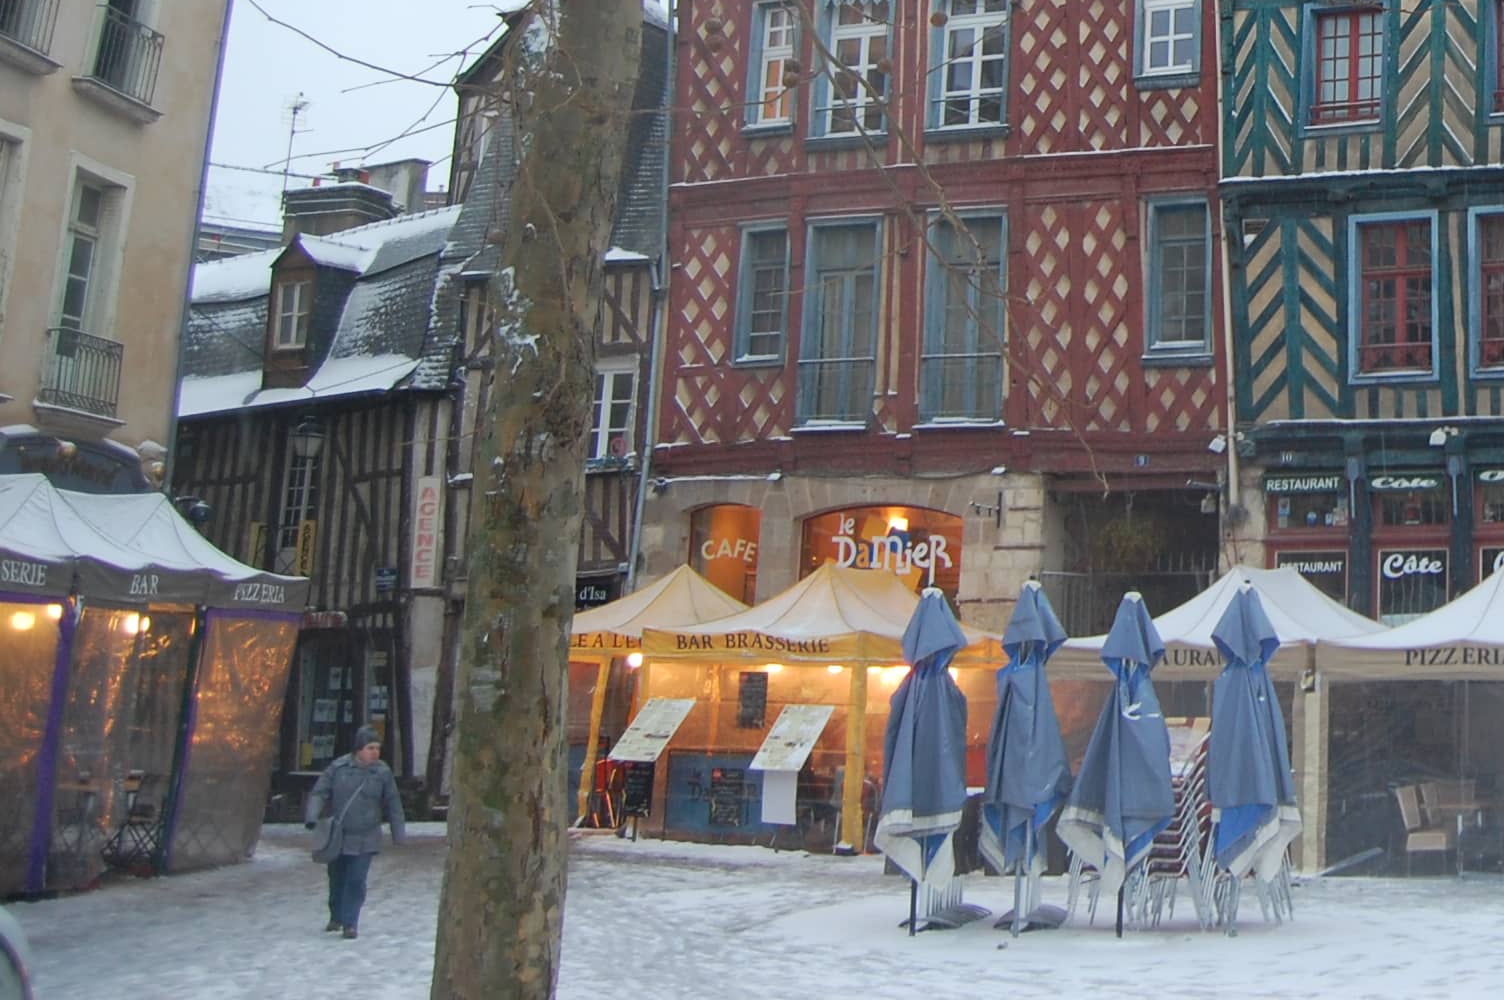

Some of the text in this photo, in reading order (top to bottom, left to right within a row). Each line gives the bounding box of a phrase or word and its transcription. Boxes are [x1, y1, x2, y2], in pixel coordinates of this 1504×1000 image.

[1266, 477, 1340, 491] RESTAURANT
[1371, 477, 1438, 489] Côte
[415, 486, 436, 579] AGENCE
[839, 513, 855, 534] le
[701, 537, 757, 562] CAFE
[1383, 553, 1444, 579] Côte
[130, 574, 159, 595] BAR
[234, 583, 286, 603] PIZZERIA
[579, 586, 607, 600] d'Isa
[676, 633, 830, 653] BAR BRASSERIE
